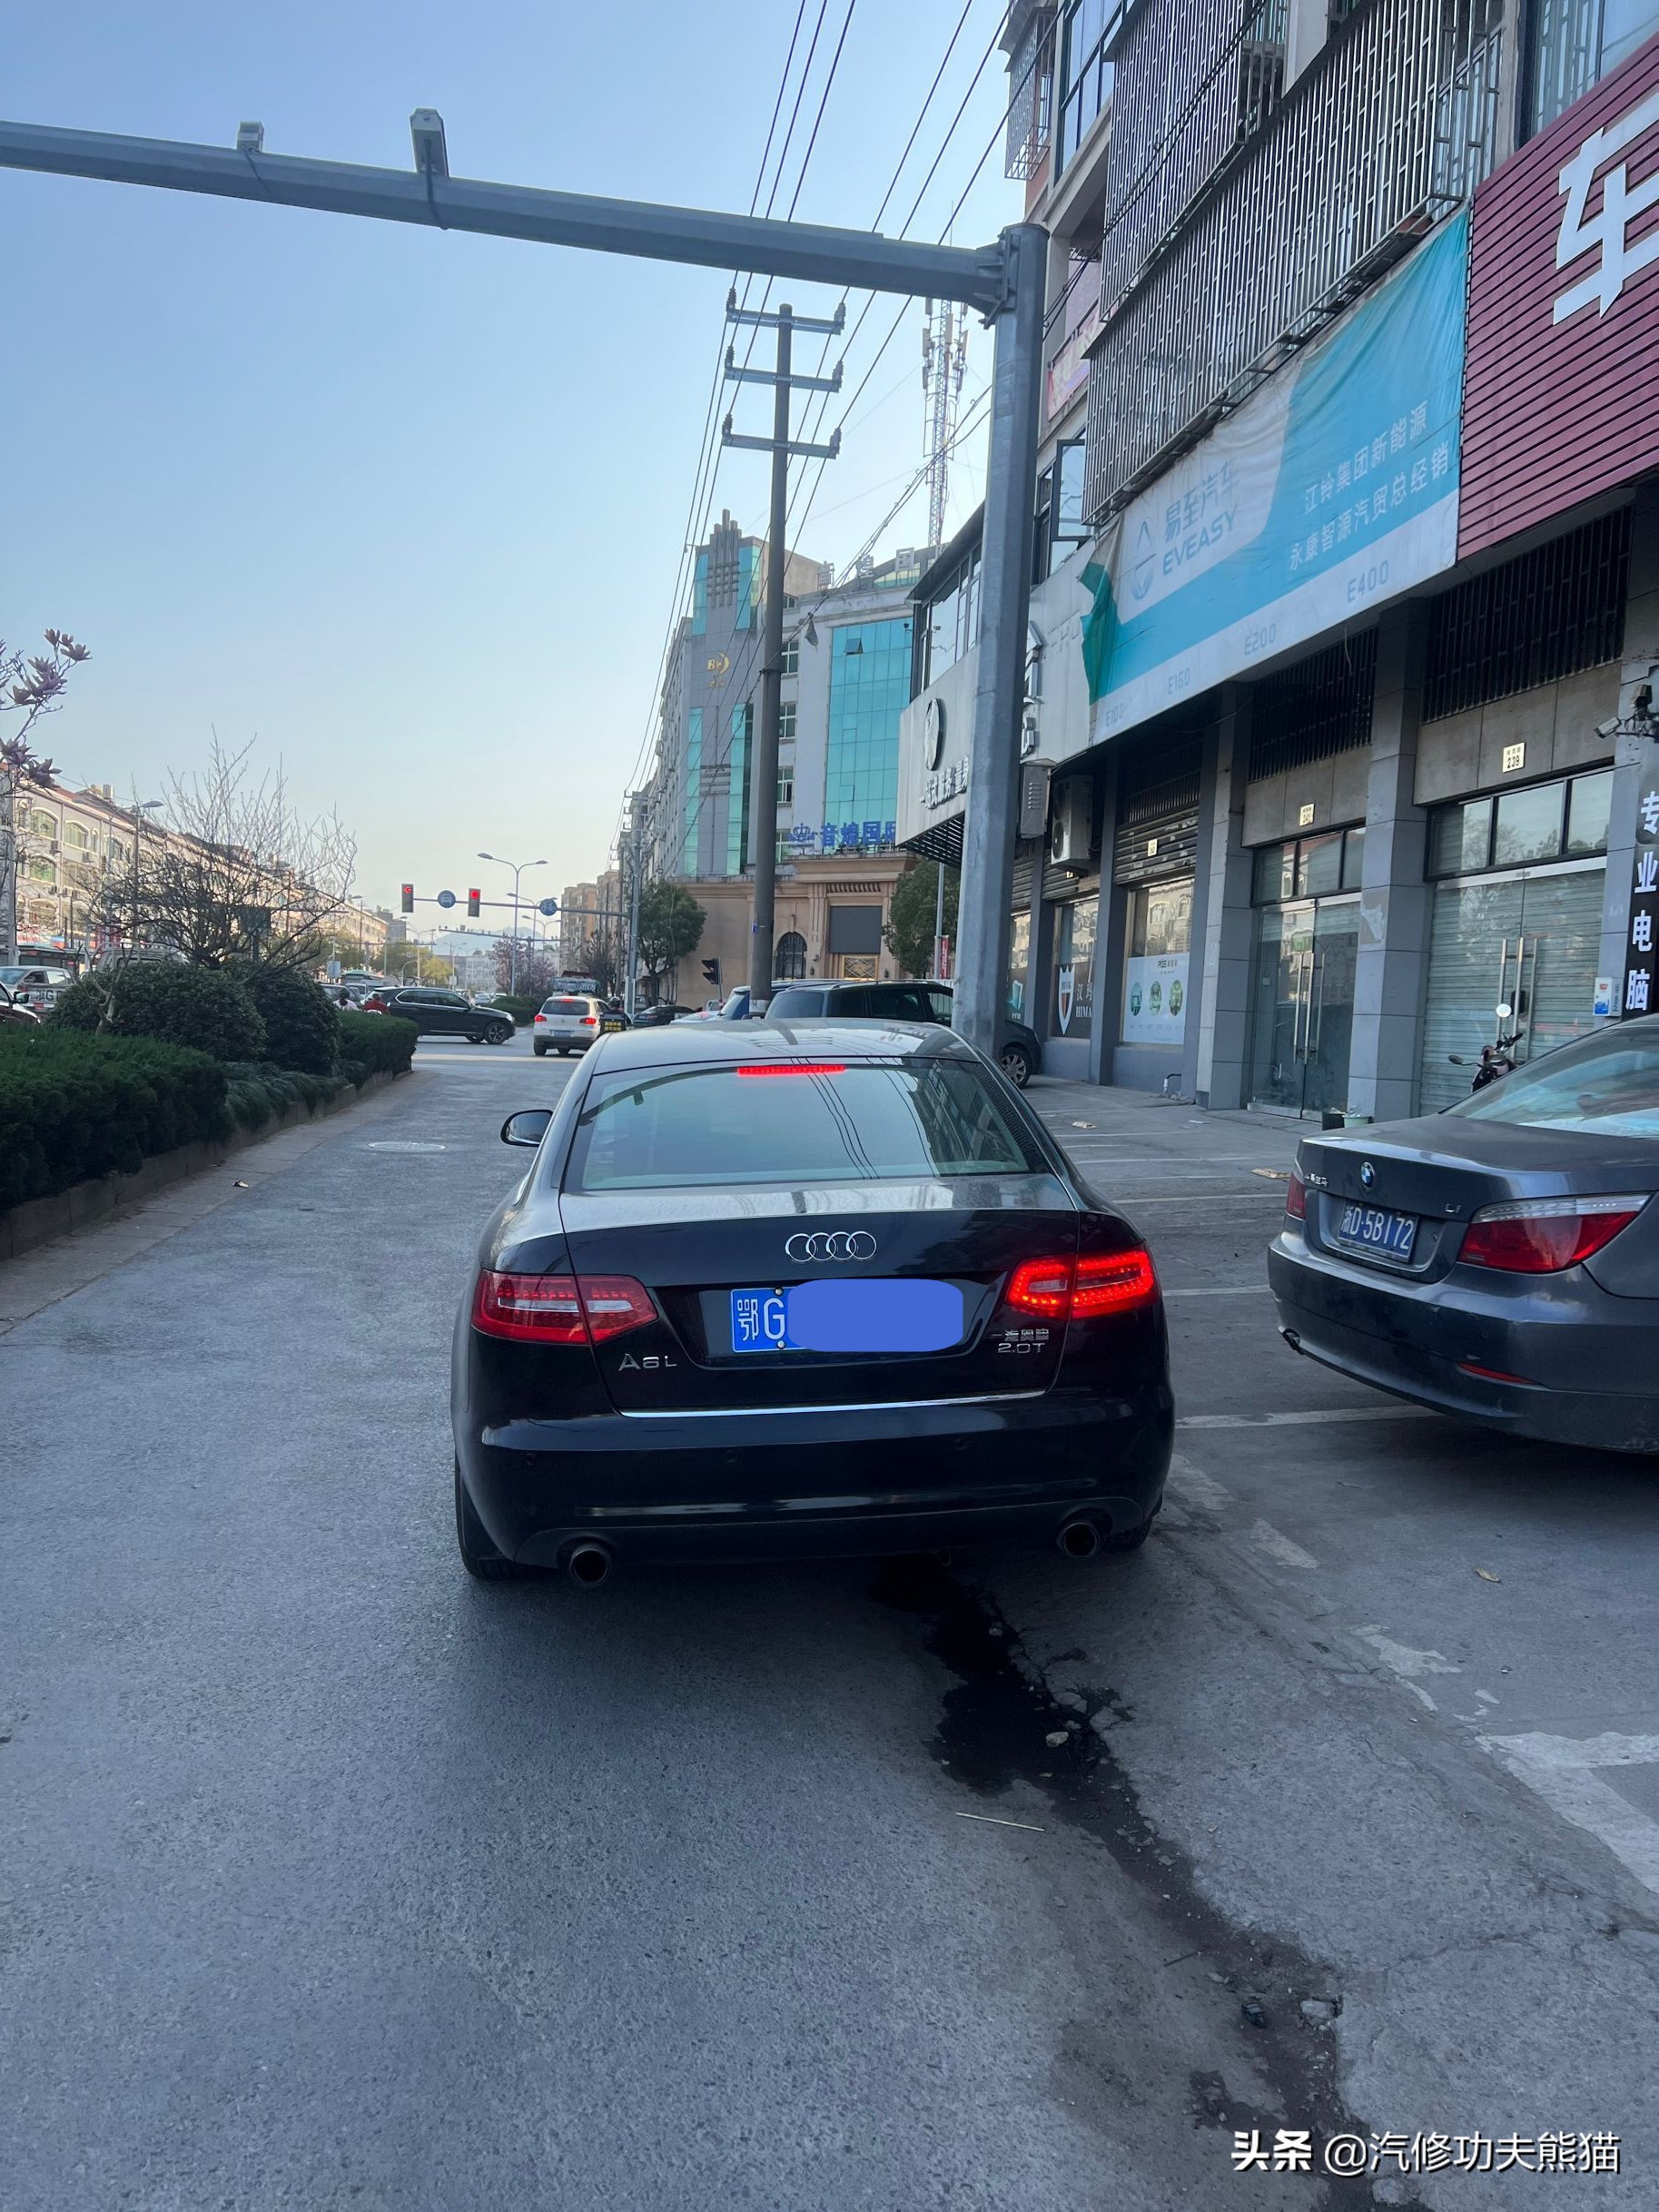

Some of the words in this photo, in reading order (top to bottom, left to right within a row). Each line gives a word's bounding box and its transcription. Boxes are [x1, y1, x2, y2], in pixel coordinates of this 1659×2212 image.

[1553, 92, 1659, 325] 车
[1304, 400, 1428, 516] 江铃集团新能源
[1163, 504, 1238, 576] EVEASY
[1165, 460, 1236, 543] 易至汽车
[1289, 441, 1449, 571] 永康智源汽贸总经销
[1347, 560, 1389, 604] E400
[1244, 624, 1276, 657] E200
[1625, 790, 1659, 1012] 专业电脑
[998, 1342, 1046, 1354] 2.0T
